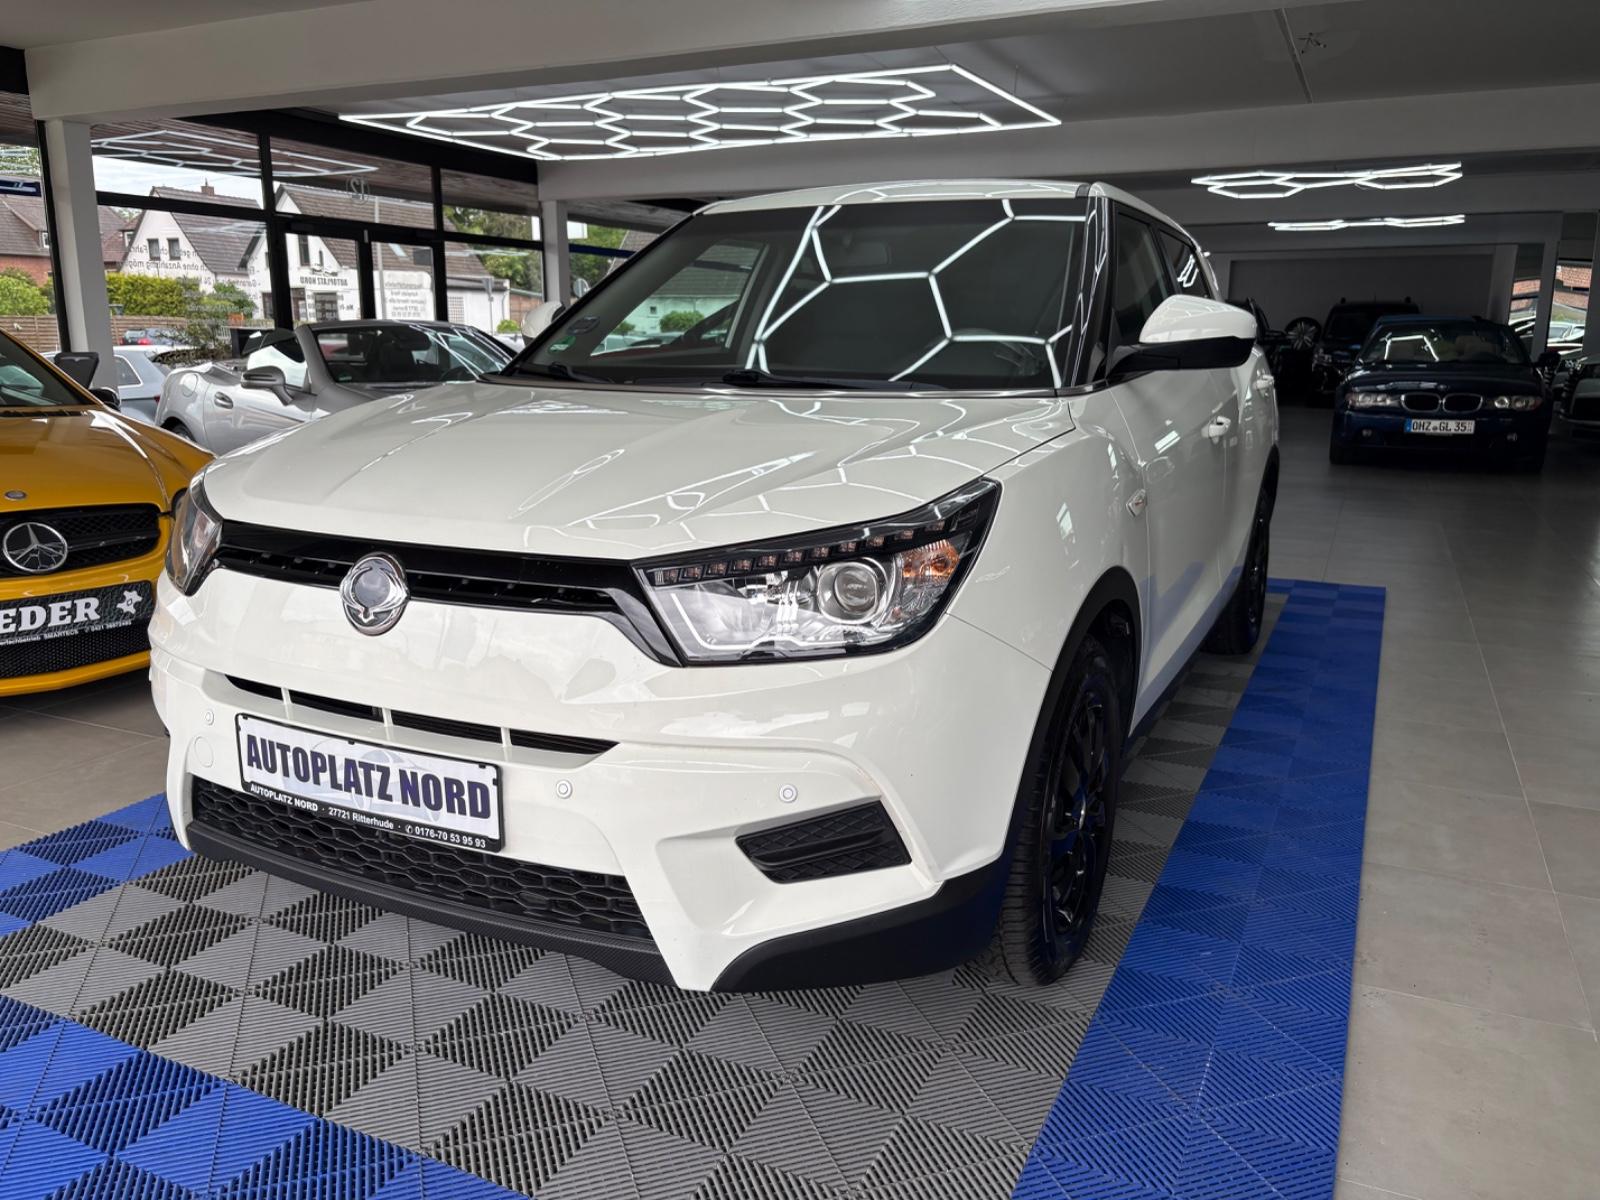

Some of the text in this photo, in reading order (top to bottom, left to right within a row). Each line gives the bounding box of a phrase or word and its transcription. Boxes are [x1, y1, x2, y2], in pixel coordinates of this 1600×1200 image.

[1439, 421, 1452, 432] GL
[1454, 421, 1467, 432] 35
[247, 734, 491, 820] AUTOPLATZ NORD
[250, 784, 486, 849] AUTOPLATZ NORD 27721 Ritterhude 0176-70 53 95 93
